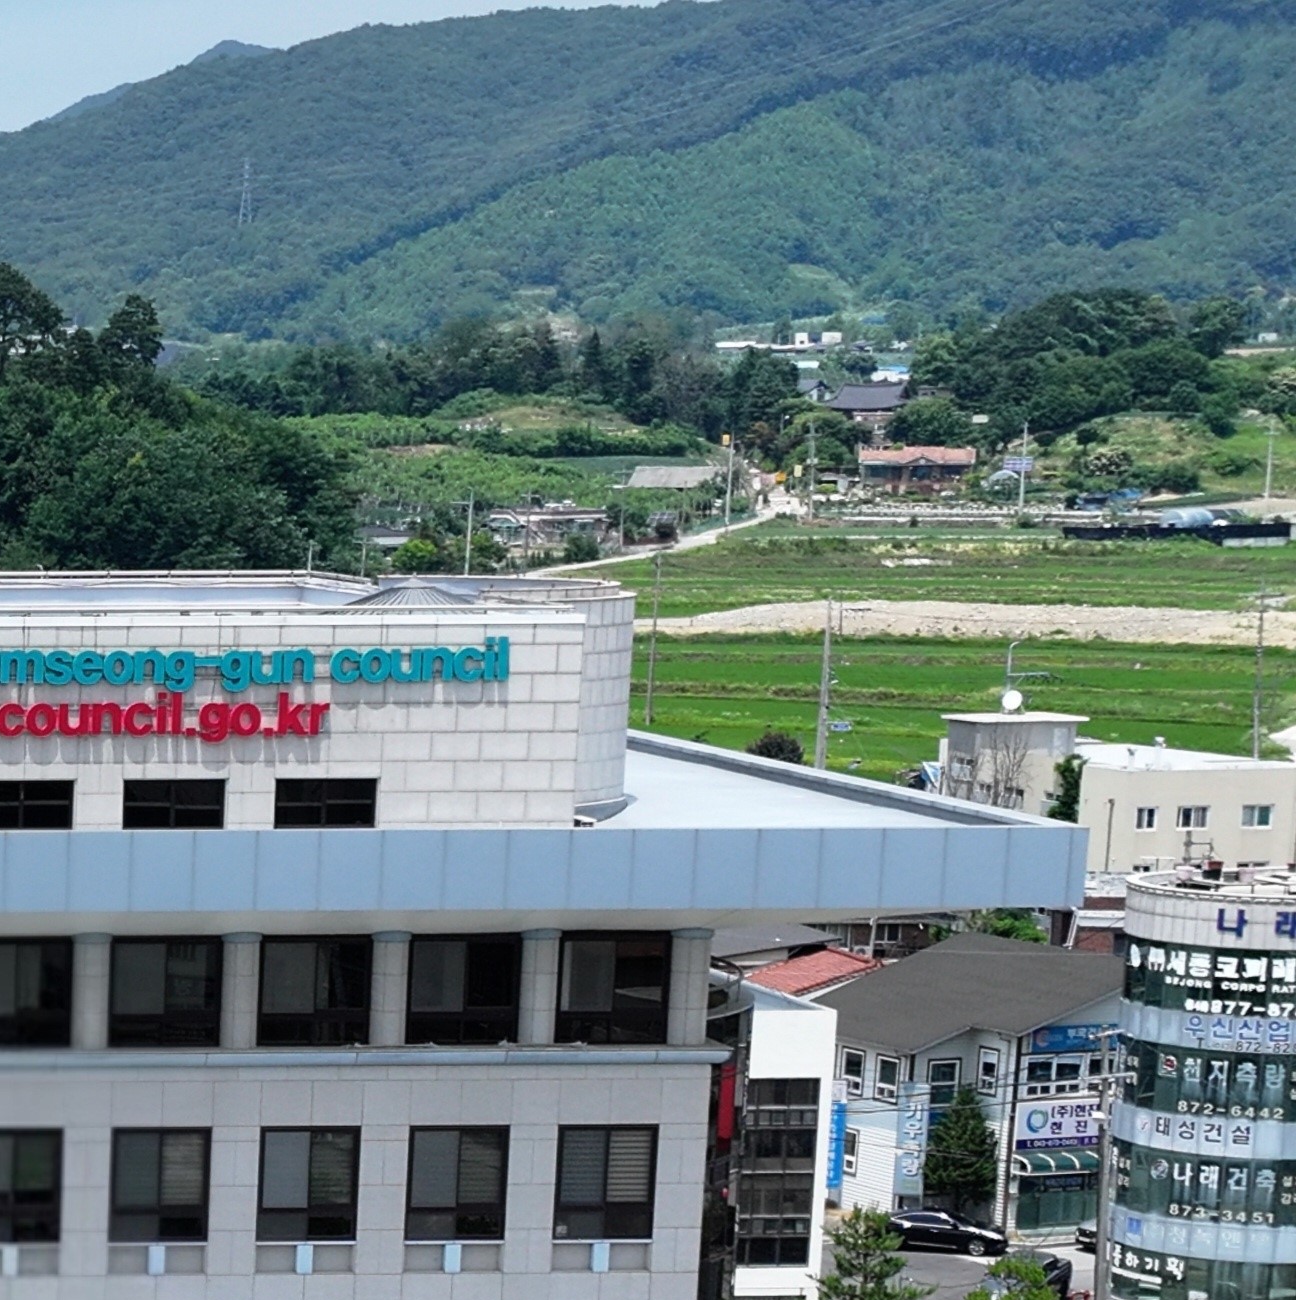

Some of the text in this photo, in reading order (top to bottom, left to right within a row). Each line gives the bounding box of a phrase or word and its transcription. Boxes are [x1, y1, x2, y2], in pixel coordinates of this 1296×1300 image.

[330, 636, 510, 684] council
[1185, 1015, 1290, 1042] 우신산업
[1183, 1057, 1285, 1089] 천지측량
[1177, 1100, 1284, 1120] 872-6442
[1156, 1116, 1251, 1146] 태성건설
[1173, 1162, 1276, 1193] 나래건축
[1169, 1203, 1276, 1225] 873-3451
